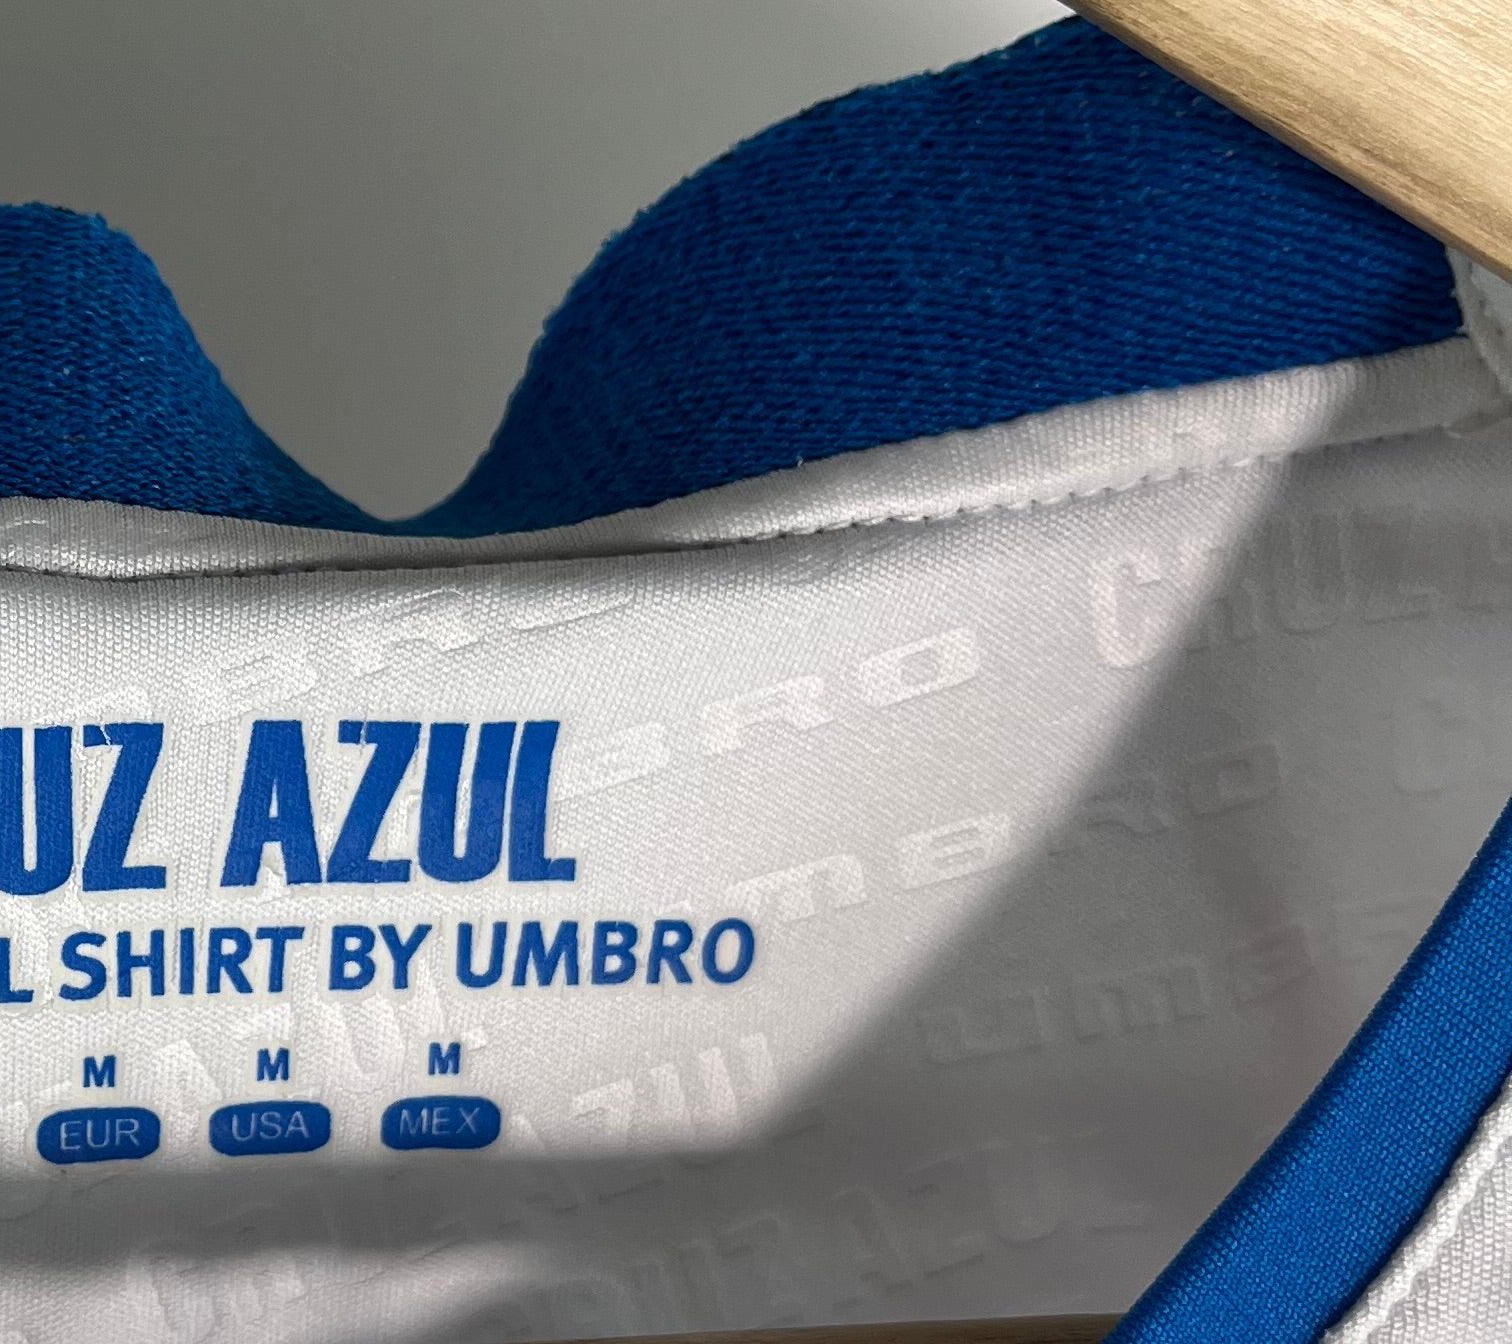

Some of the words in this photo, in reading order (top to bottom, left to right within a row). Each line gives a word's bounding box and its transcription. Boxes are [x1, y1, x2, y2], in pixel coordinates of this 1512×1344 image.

[221, 721, 576, 887] AZUL
[60, 927, 304, 1001] SHIRT
[330, 925, 430, 991] BY
[457, 920, 754, 989] UMBRO
[84, 1056, 116, 1088] M
[258, 1049, 289, 1081] M
[430, 1043, 460, 1074] M
[59, 1119, 141, 1151] EUR
[230, 1110, 311, 1142] USA
[398, 1105, 481, 1136] MEX
